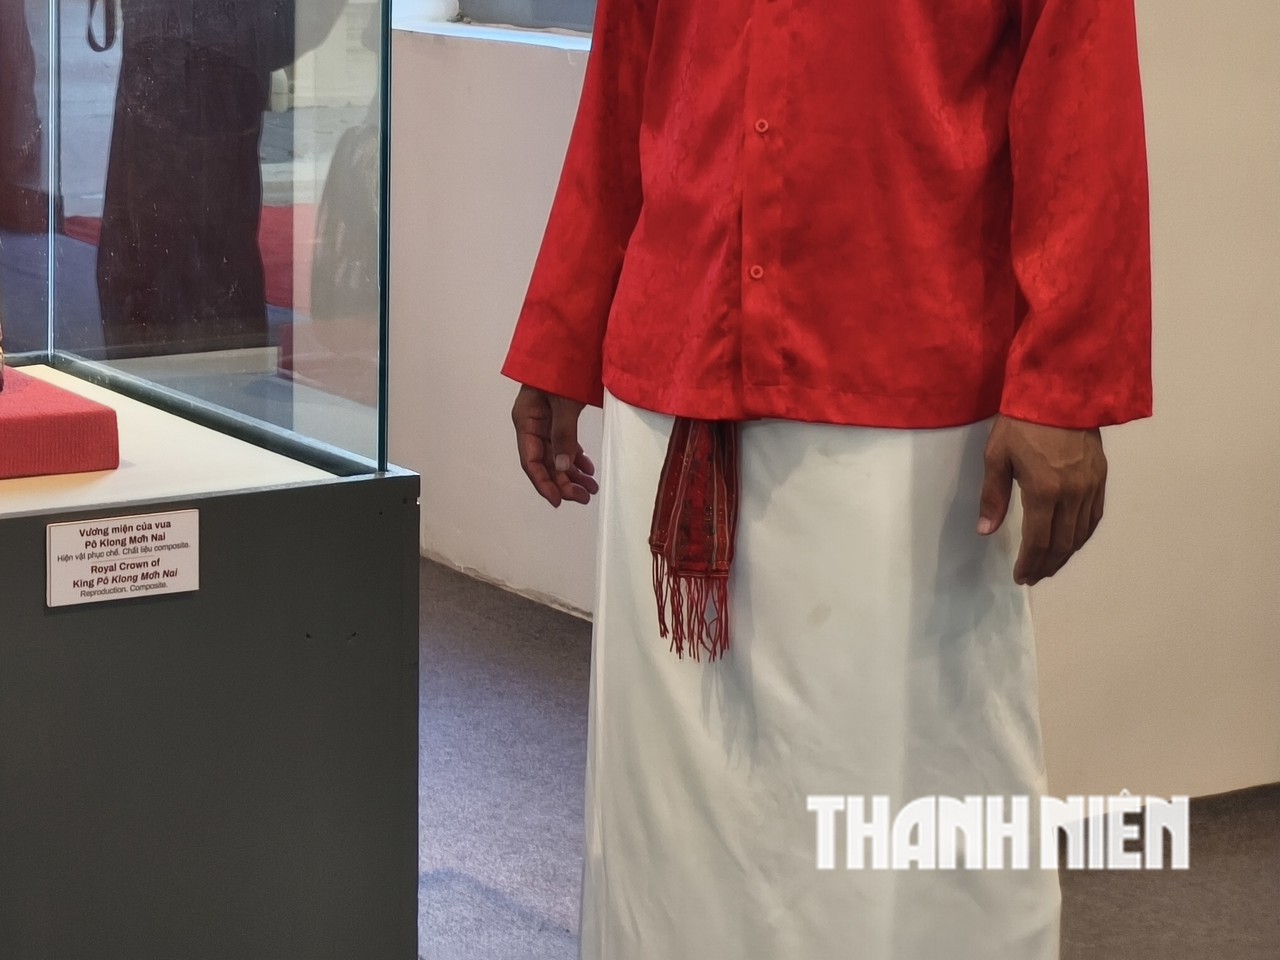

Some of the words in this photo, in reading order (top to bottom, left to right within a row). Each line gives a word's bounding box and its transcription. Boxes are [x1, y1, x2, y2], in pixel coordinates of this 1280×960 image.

[112, 523, 133, 534] miện
[136, 521, 152, 531] của
[155, 521, 171, 529] vua
[154, 542, 190, 553] composite.
[91, 563, 117, 575] Royal
[119, 561, 148, 571] Crown
[151, 558, 161, 567] of
[73, 579, 94, 589] King
[80, 587, 129, 598] Reproduction.
[130, 582, 168, 593] Composite.
